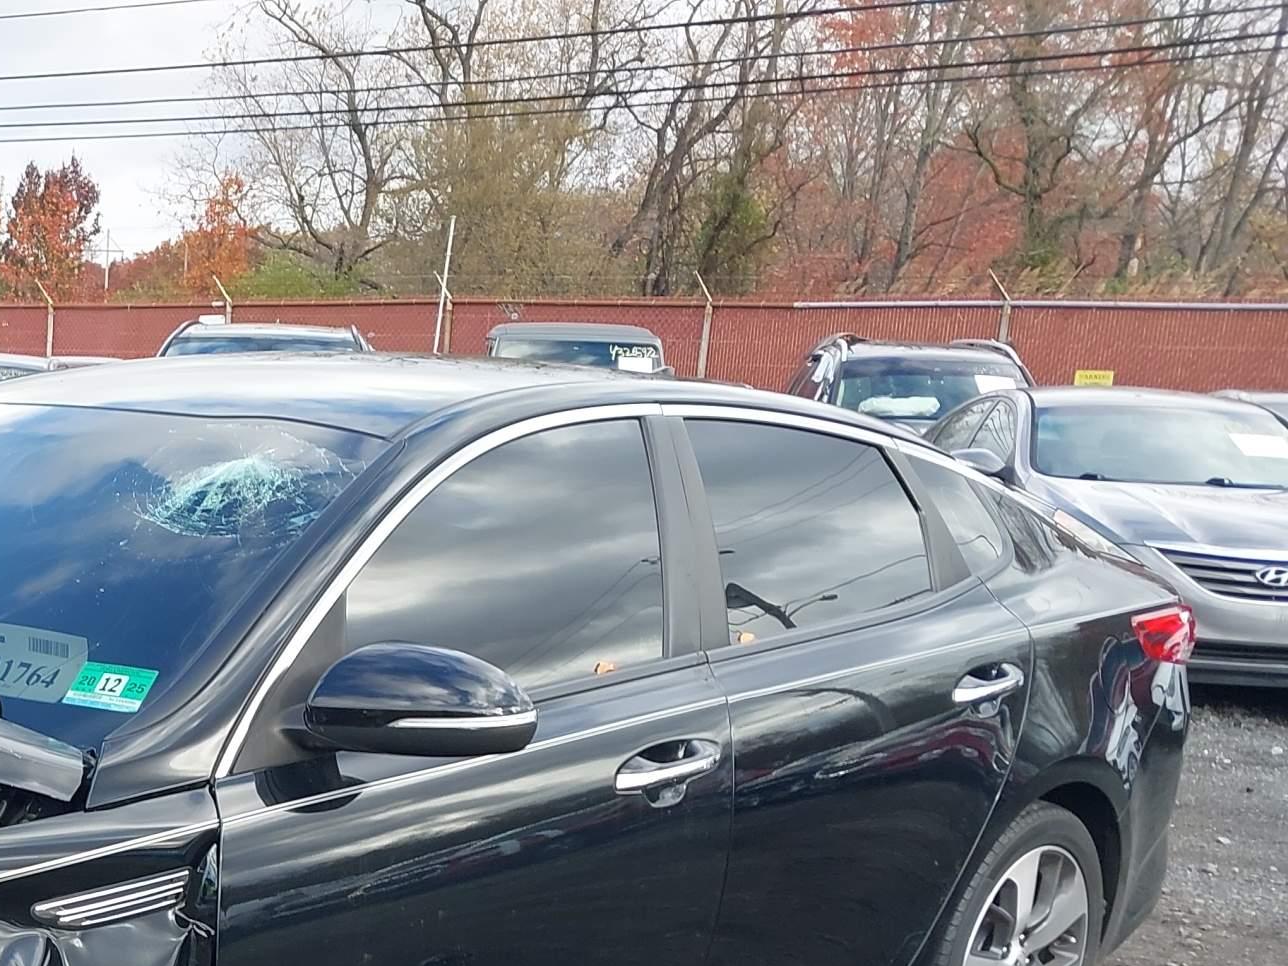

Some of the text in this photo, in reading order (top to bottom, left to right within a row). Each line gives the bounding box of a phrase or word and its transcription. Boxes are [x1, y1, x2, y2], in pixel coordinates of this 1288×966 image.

[78, 675, 147, 694] 20 12 25
